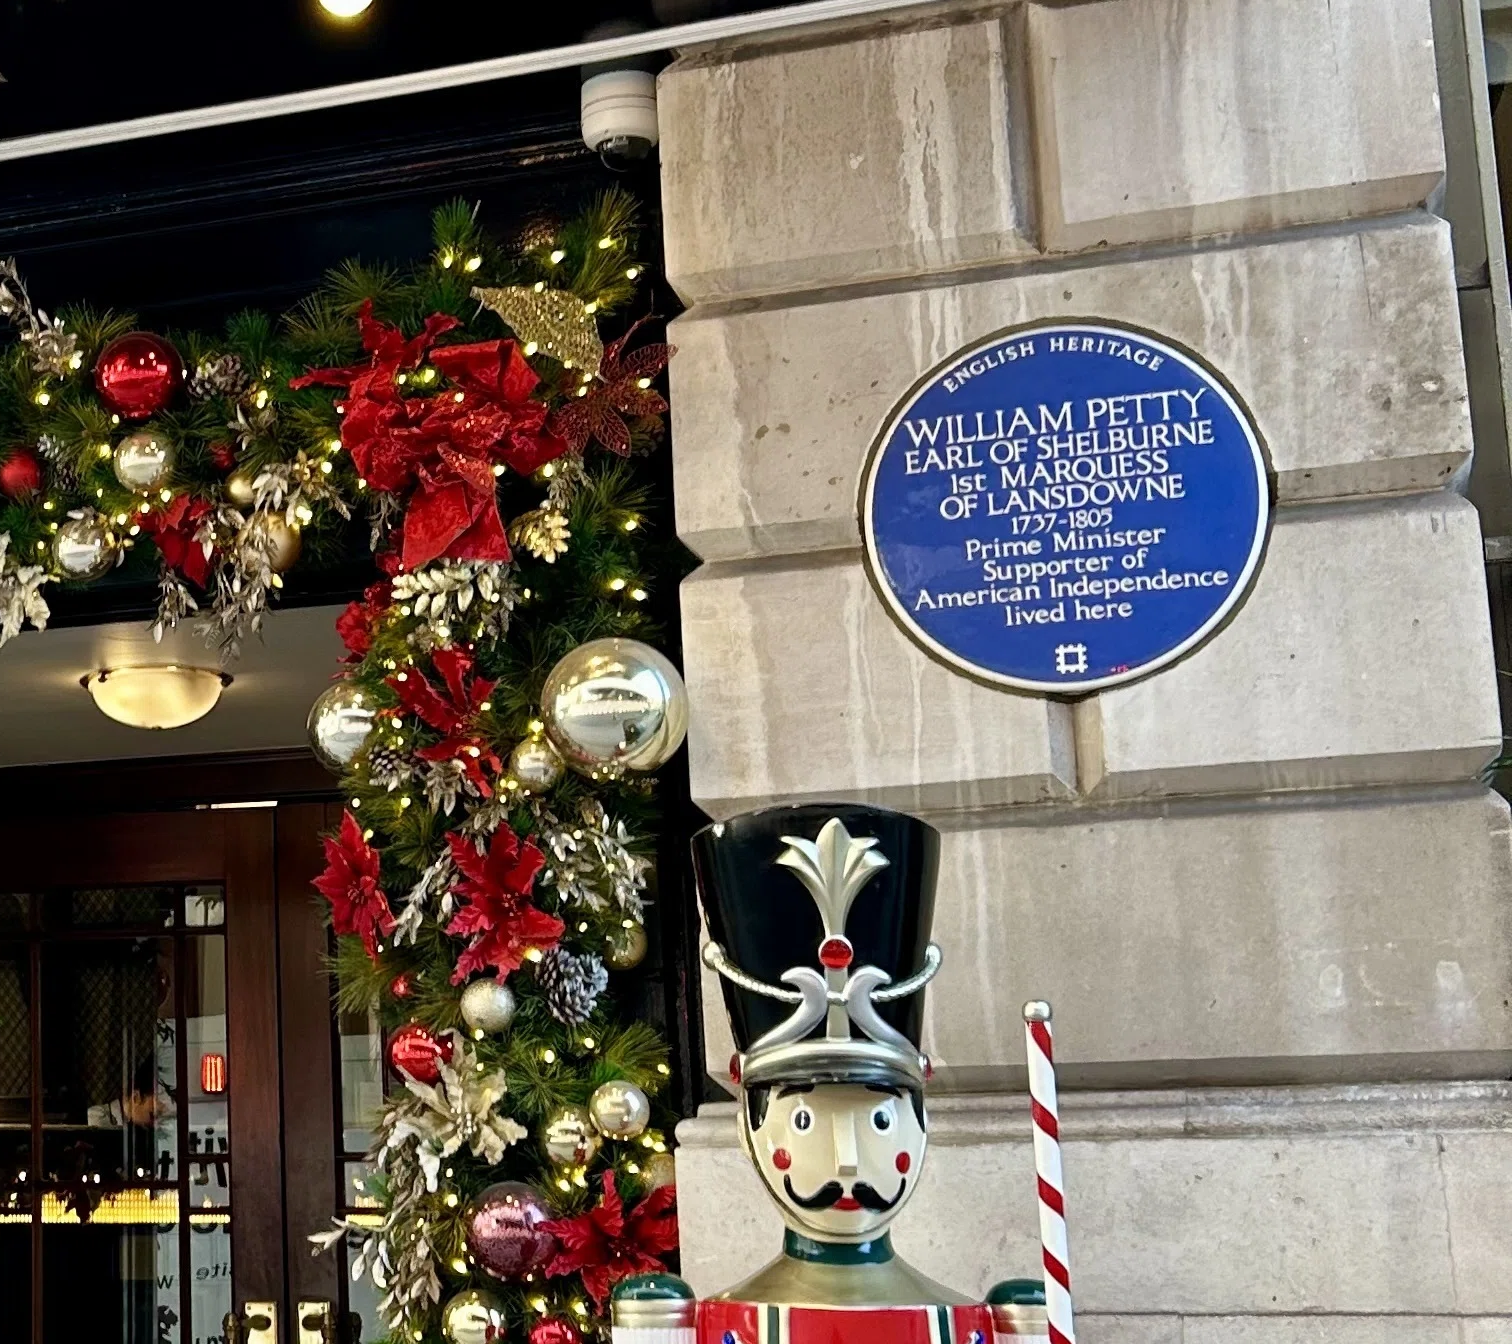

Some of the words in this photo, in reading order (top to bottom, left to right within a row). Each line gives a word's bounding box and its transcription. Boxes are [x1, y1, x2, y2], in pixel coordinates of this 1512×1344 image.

[941, 341, 1036, 394] ENGLISH
[1049, 336, 1165, 372] HERITAGE
[903, 401, 1074, 448] WILLIAM
[1087, 387, 1208, 427] PETTY
[905, 445, 983, 476] EARL
[989, 438, 1028, 465] OF
[1037, 420, 1215, 459] SHELBURNE
[951, 474, 986, 495] 1st
[1001, 451, 1169, 489] MARQUESS
[939, 495, 978, 520] OF
[987, 475, 1186, 517] LANSDOWNE
[1011, 507, 1113, 535] 1737-1805
[966, 539, 1042, 561] Prime
[1053, 527, 1166, 553] Minister
[982, 555, 1114, 585] Supporter
[1121, 548, 1148, 571] of
[915, 585, 1041, 611] American
[1050, 568, 1229, 603] Independence
[1005, 607, 1065, 627] lived
[1075, 600, 1133, 619] here
